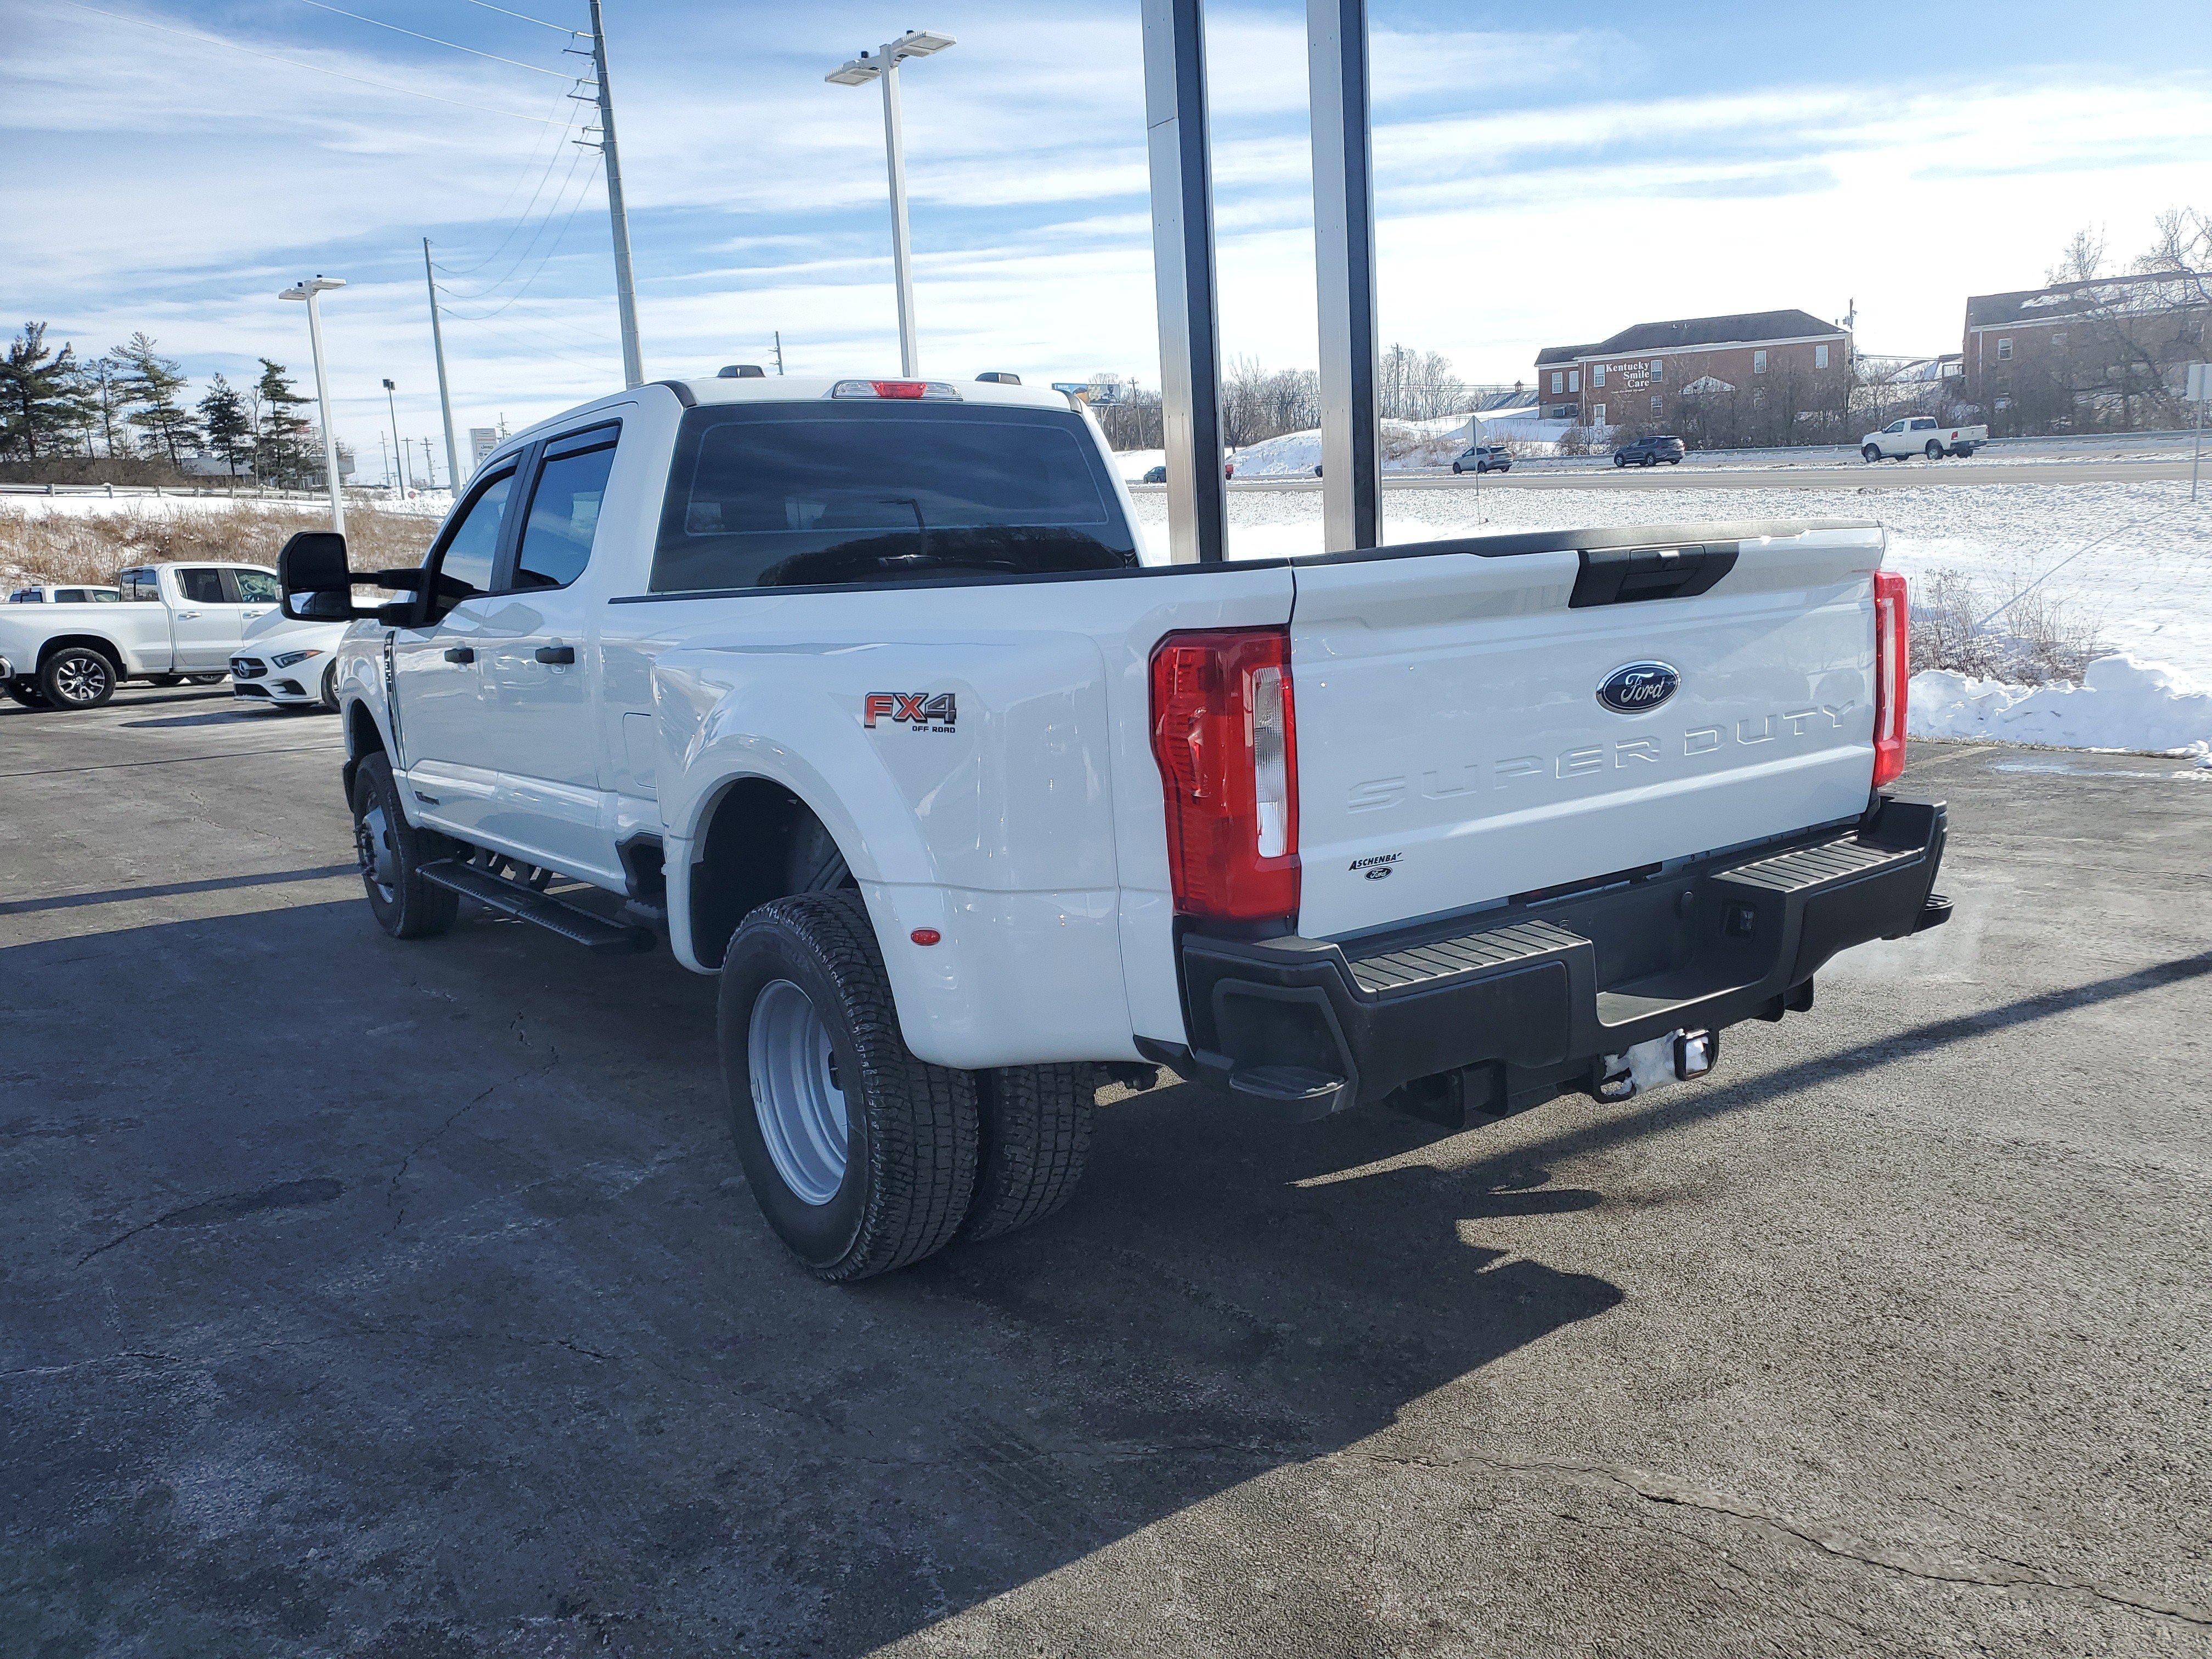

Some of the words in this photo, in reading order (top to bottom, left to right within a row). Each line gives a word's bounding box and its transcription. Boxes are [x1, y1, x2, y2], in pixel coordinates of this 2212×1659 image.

[1606, 362, 1649, 373] Kentucky
[1623, 370, 1650, 380] Smile
[1627, 380, 1650, 388] Care
[1621, 672, 1665, 703] Ford
[864, 692, 957, 729] FX4
[1347, 736, 1661, 814] SUPER
[1684, 699, 1855, 756] DUTY
[1348, 852, 1403, 871] ASCHENBA
[1370, 868, 1387, 878] Ford
